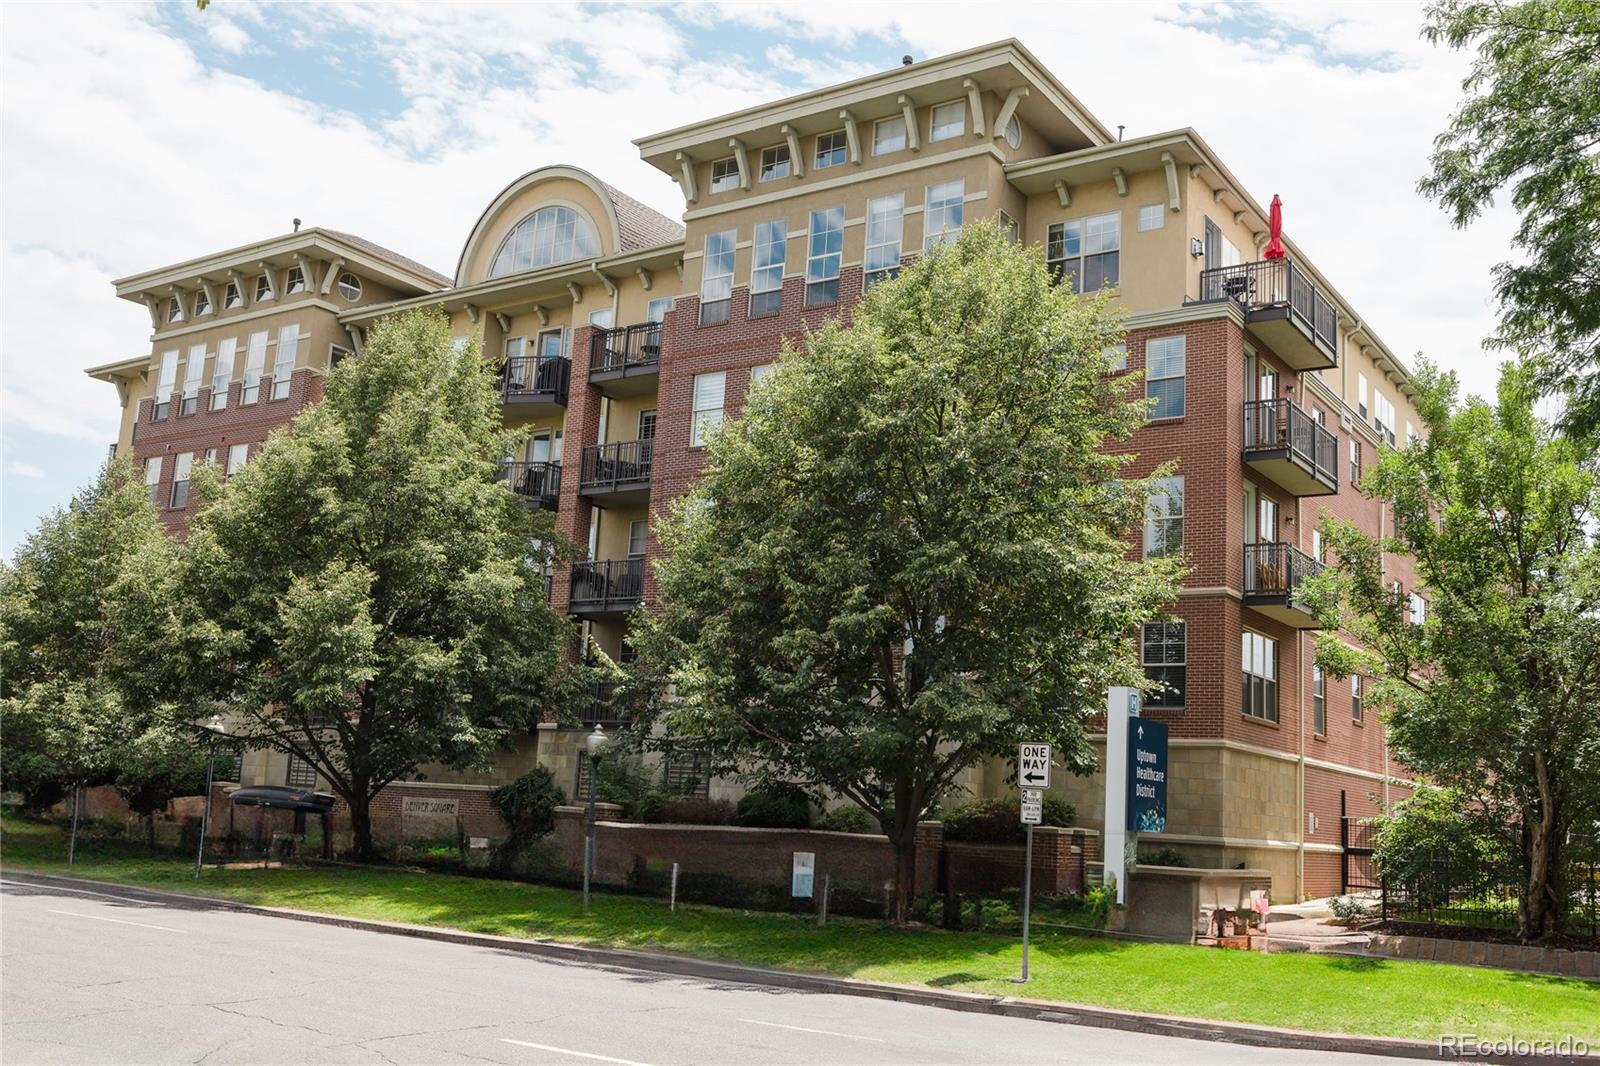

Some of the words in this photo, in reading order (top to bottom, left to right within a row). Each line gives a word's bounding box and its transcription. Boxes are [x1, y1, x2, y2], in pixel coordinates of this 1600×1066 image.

[1024, 746, 1046, 757] ONE
[1136, 748, 1157, 764] Uptown
[1022, 759, 1047, 770] WAY
[1136, 766, 1164, 782] Healthcare
[1136, 783, 1155, 798] District
